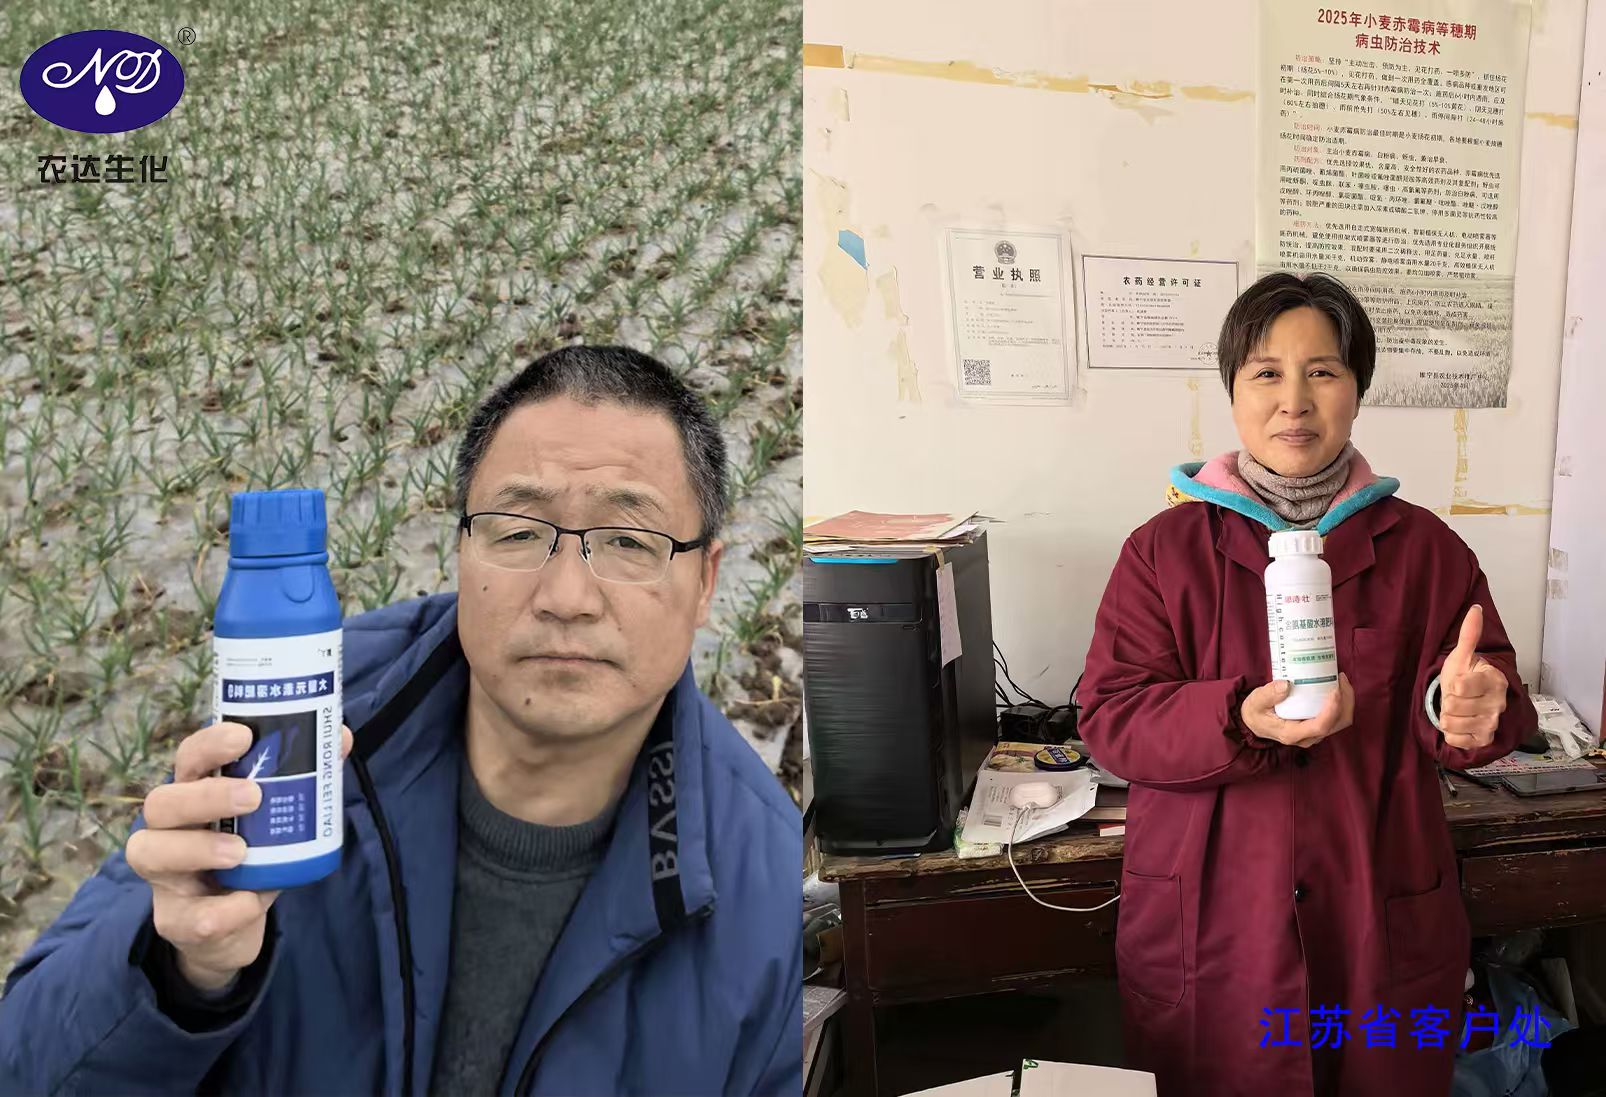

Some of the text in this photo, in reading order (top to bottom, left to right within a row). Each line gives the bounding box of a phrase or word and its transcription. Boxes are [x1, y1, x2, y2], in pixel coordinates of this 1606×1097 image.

[1317, 8, 1477, 41] 2025年小麦赤霉病等穗期
[1355, 32, 1441, 55] 病虫防治技术
[972, 265, 1042, 282] 营业执照
[1122, 276, 1202, 288] 农药经营许可证
